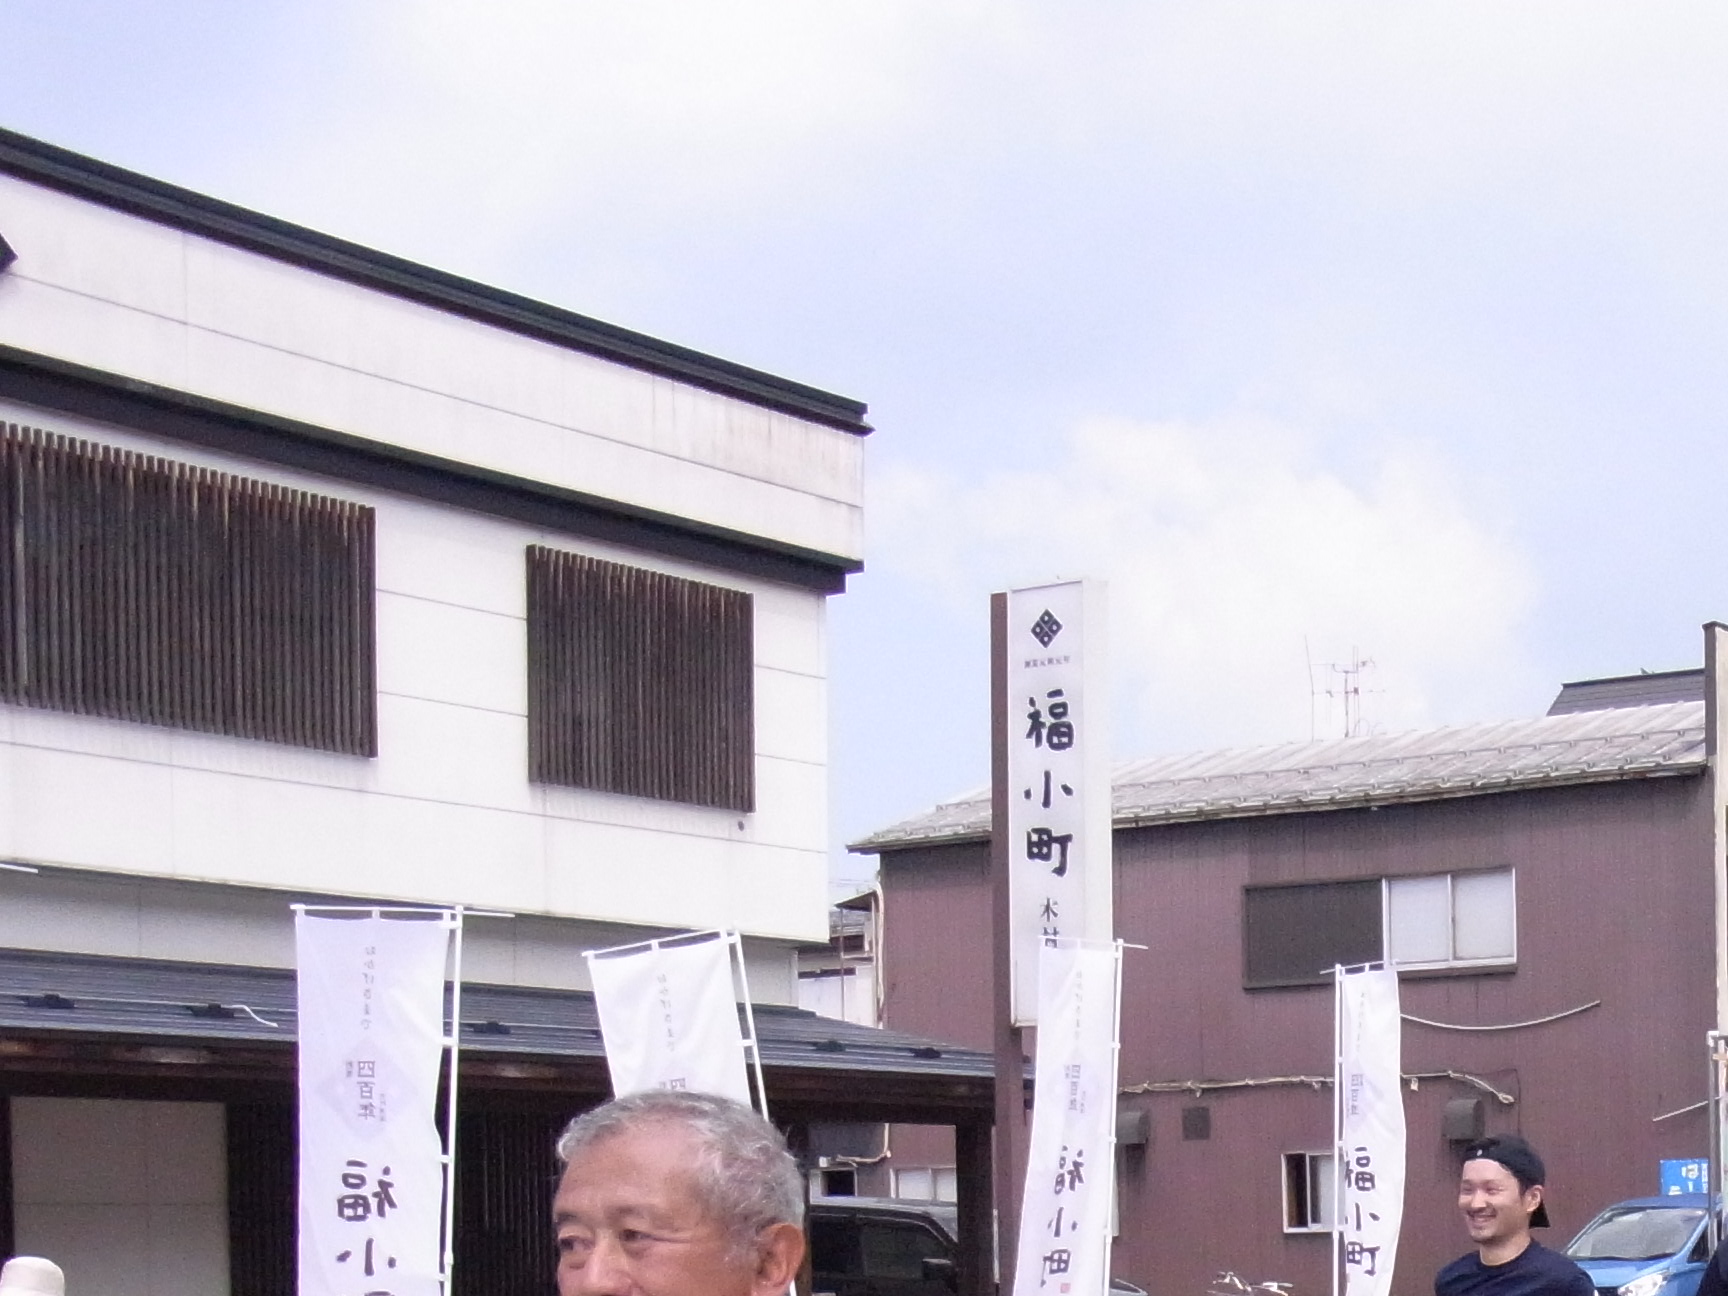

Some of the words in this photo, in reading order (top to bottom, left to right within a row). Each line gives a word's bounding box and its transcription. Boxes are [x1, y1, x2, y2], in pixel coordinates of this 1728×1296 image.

[1025, 688, 1075, 878] 福小町
[1345, 1146, 1381, 1277] 福小町
